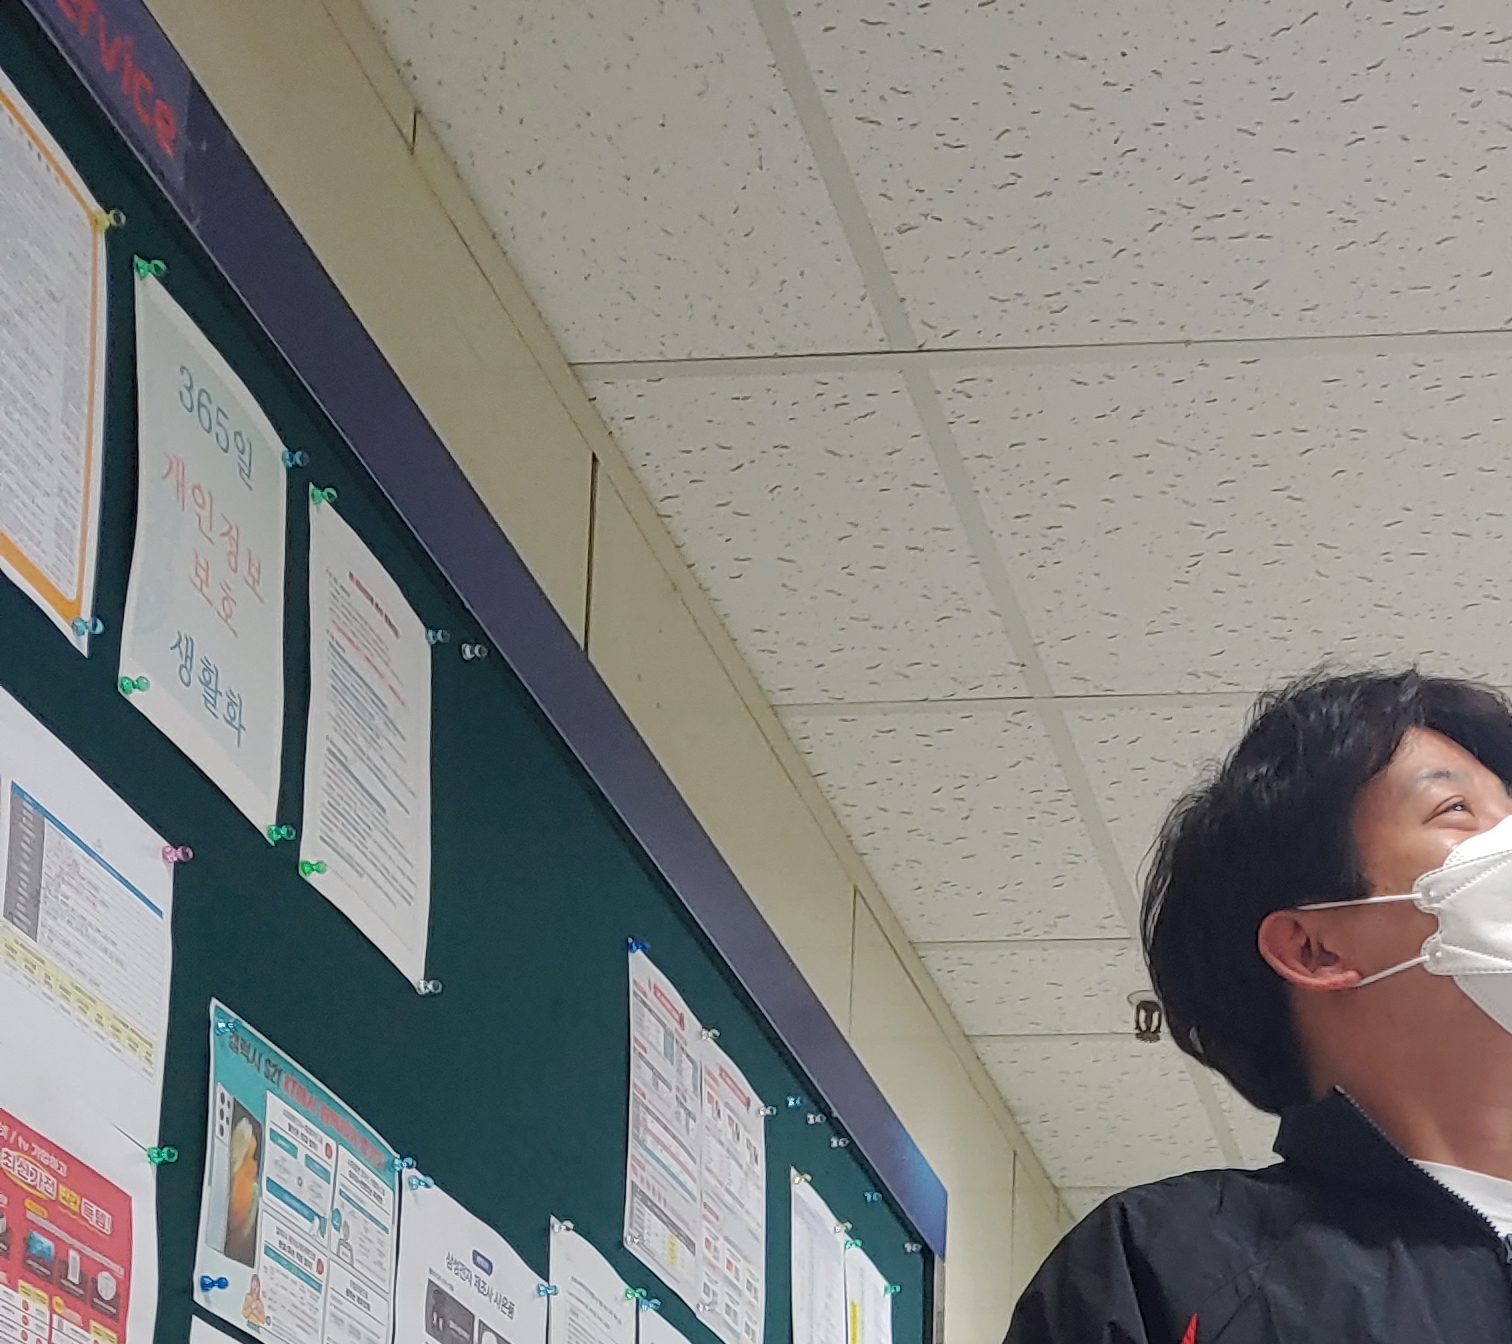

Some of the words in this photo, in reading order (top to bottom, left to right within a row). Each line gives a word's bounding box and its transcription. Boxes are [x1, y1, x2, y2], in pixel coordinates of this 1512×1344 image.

[178, 364, 254, 491] 365일
[161, 450, 265, 605] 개인정보
[190, 548, 239, 638] 보호
[169, 630, 247, 748] 생활화
[446, 1251, 474, 1290] 삼성전자
